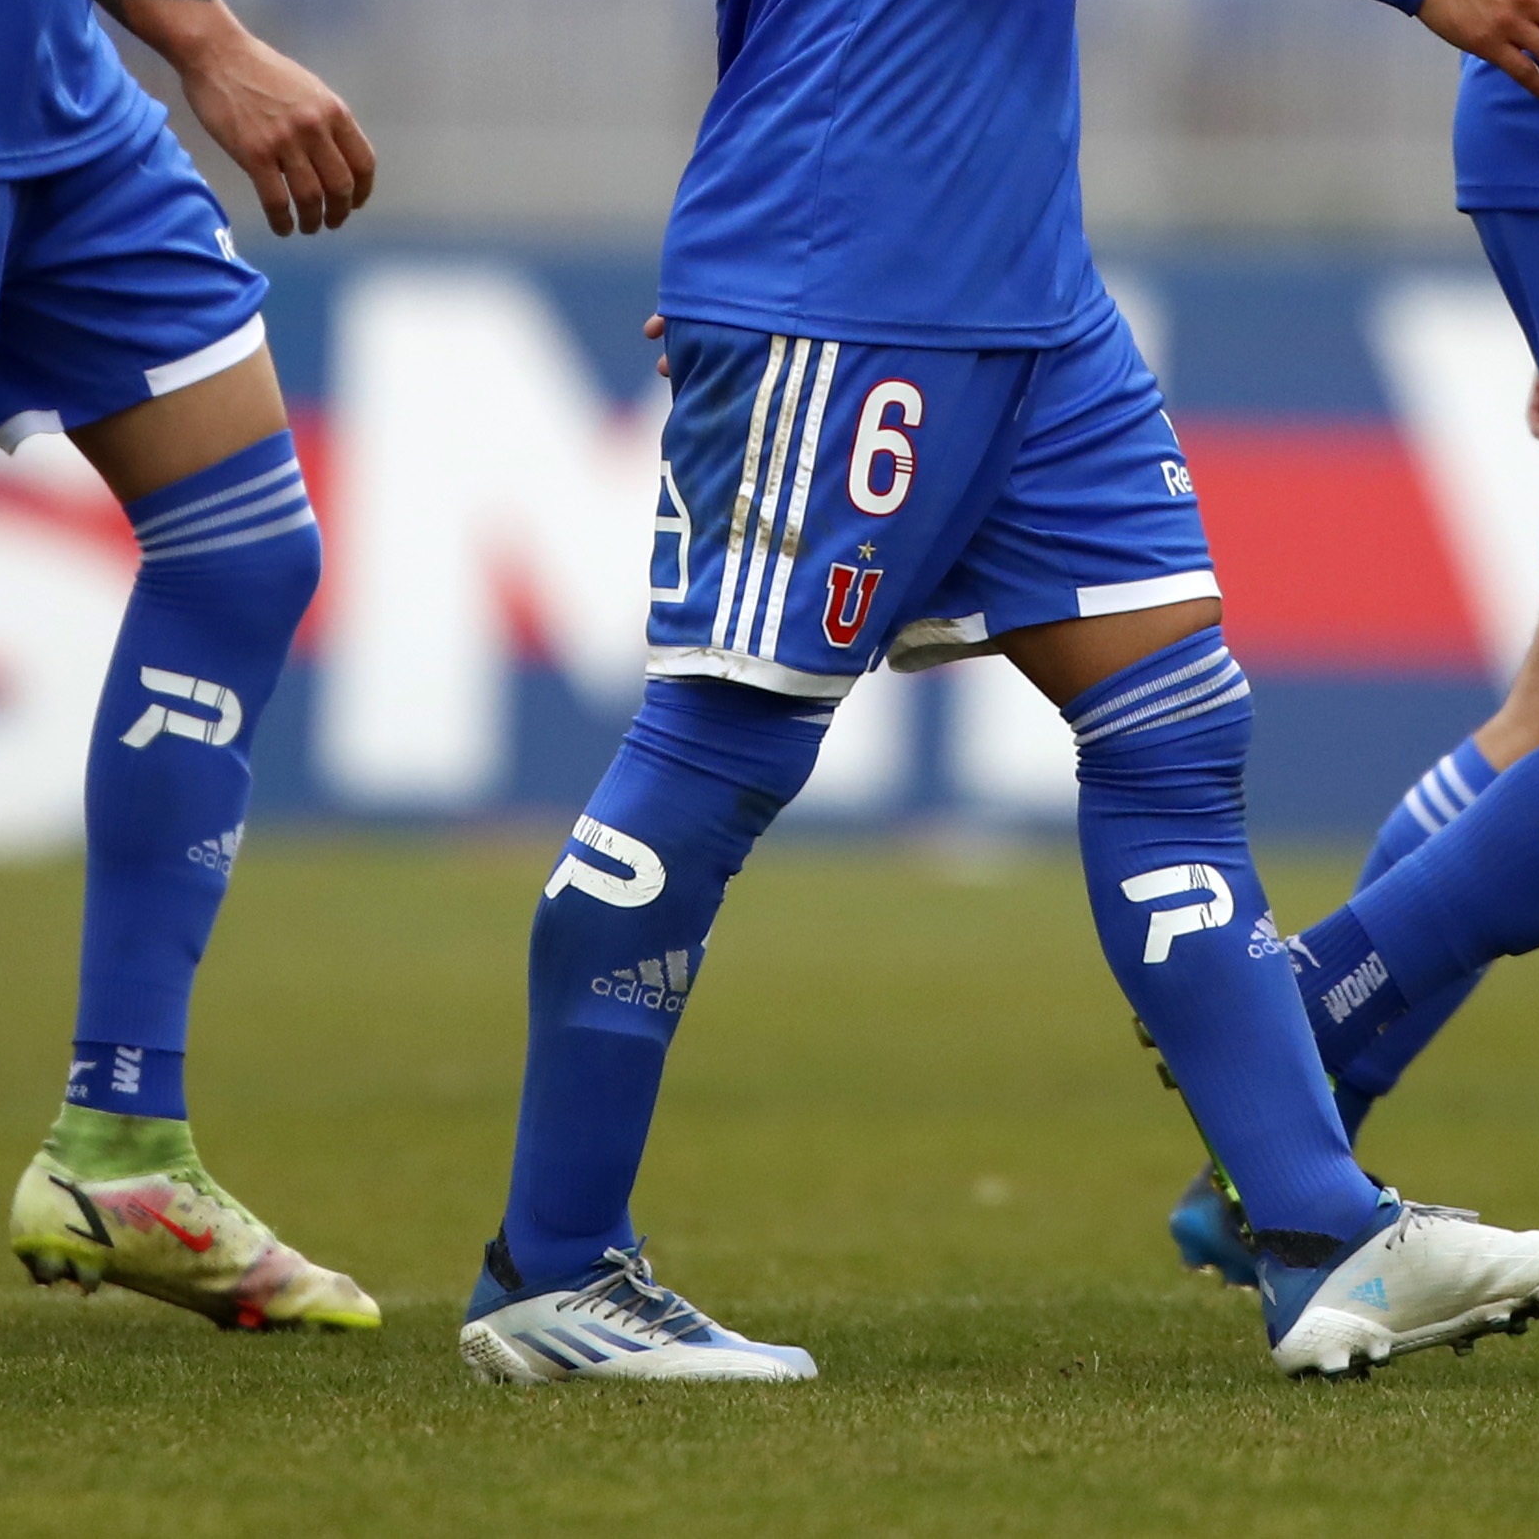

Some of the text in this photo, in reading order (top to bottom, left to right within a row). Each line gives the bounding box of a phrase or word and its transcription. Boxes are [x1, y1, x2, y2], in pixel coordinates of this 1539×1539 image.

[846, 377, 925, 518] 6
[821, 562, 883, 649] U
[591, 977, 687, 1012] adidas
